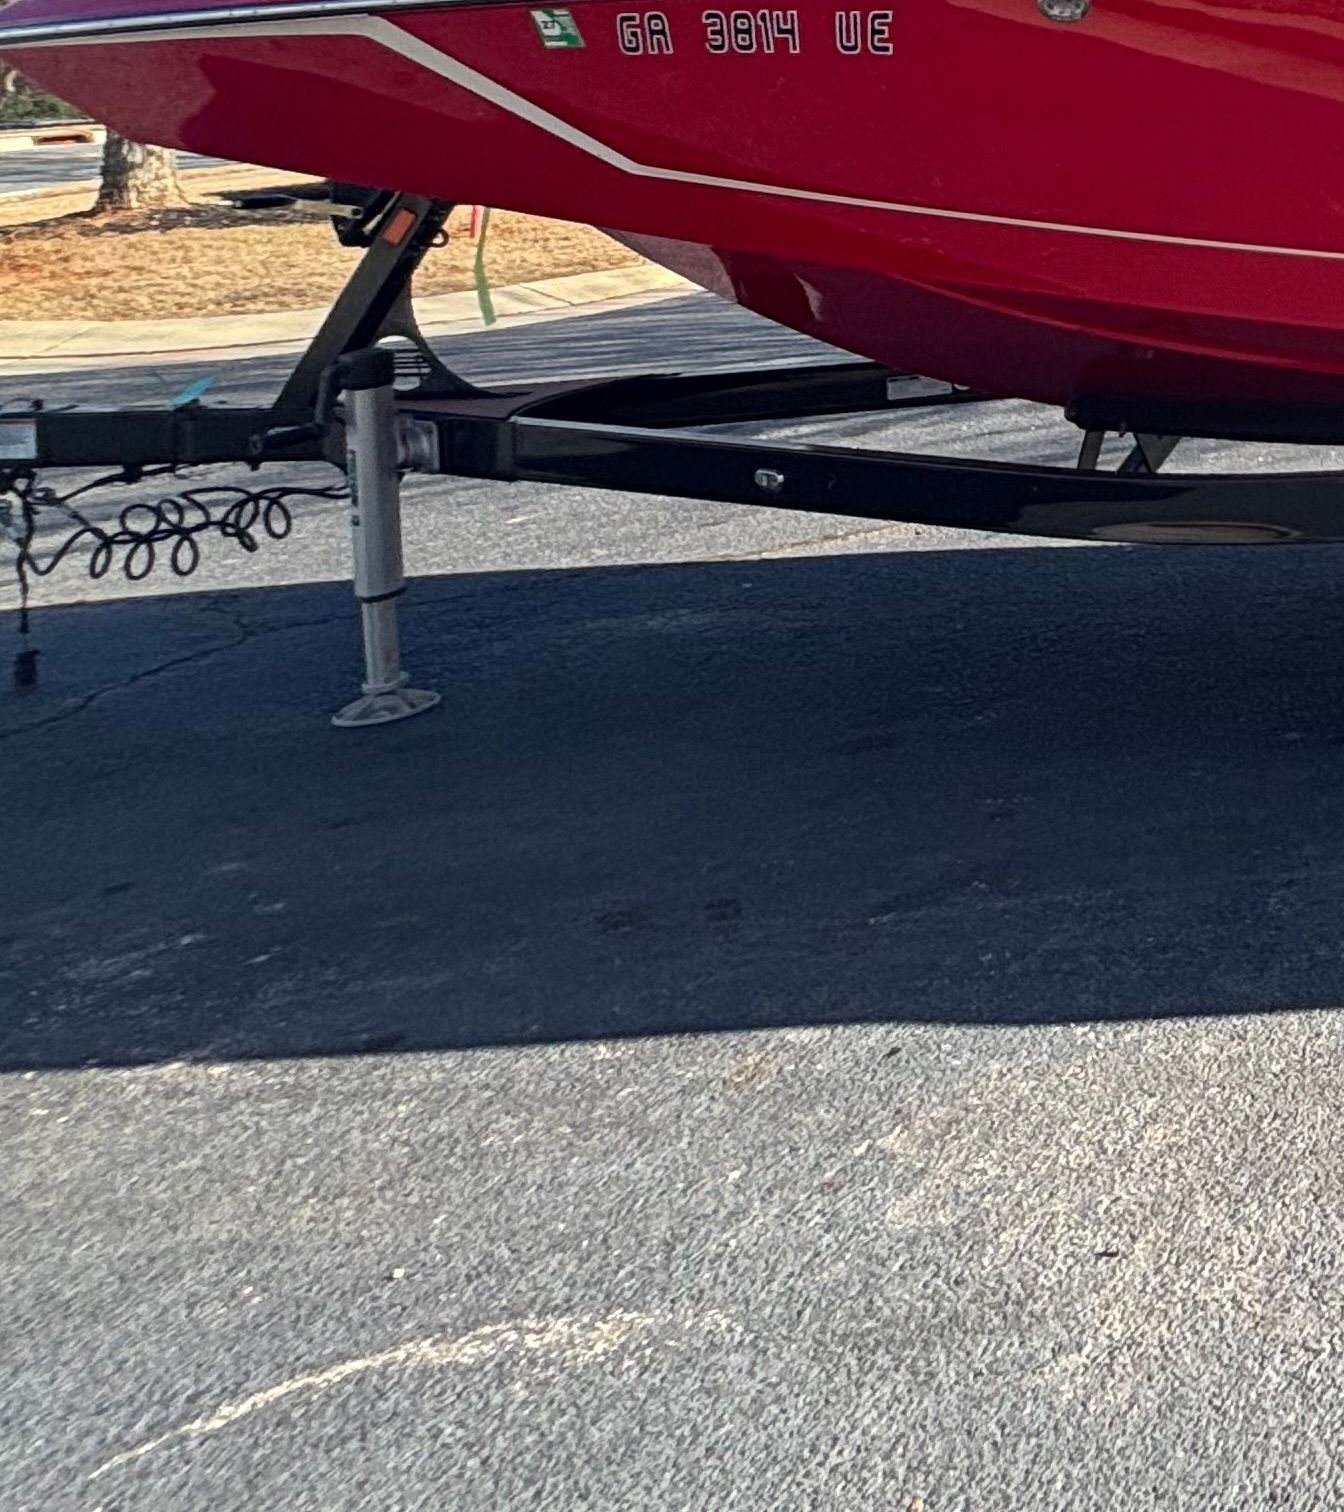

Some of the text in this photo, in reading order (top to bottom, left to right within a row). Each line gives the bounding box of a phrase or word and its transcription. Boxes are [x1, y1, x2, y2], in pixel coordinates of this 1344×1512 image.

[616, 9, 893, 55] GA 3814 UE
